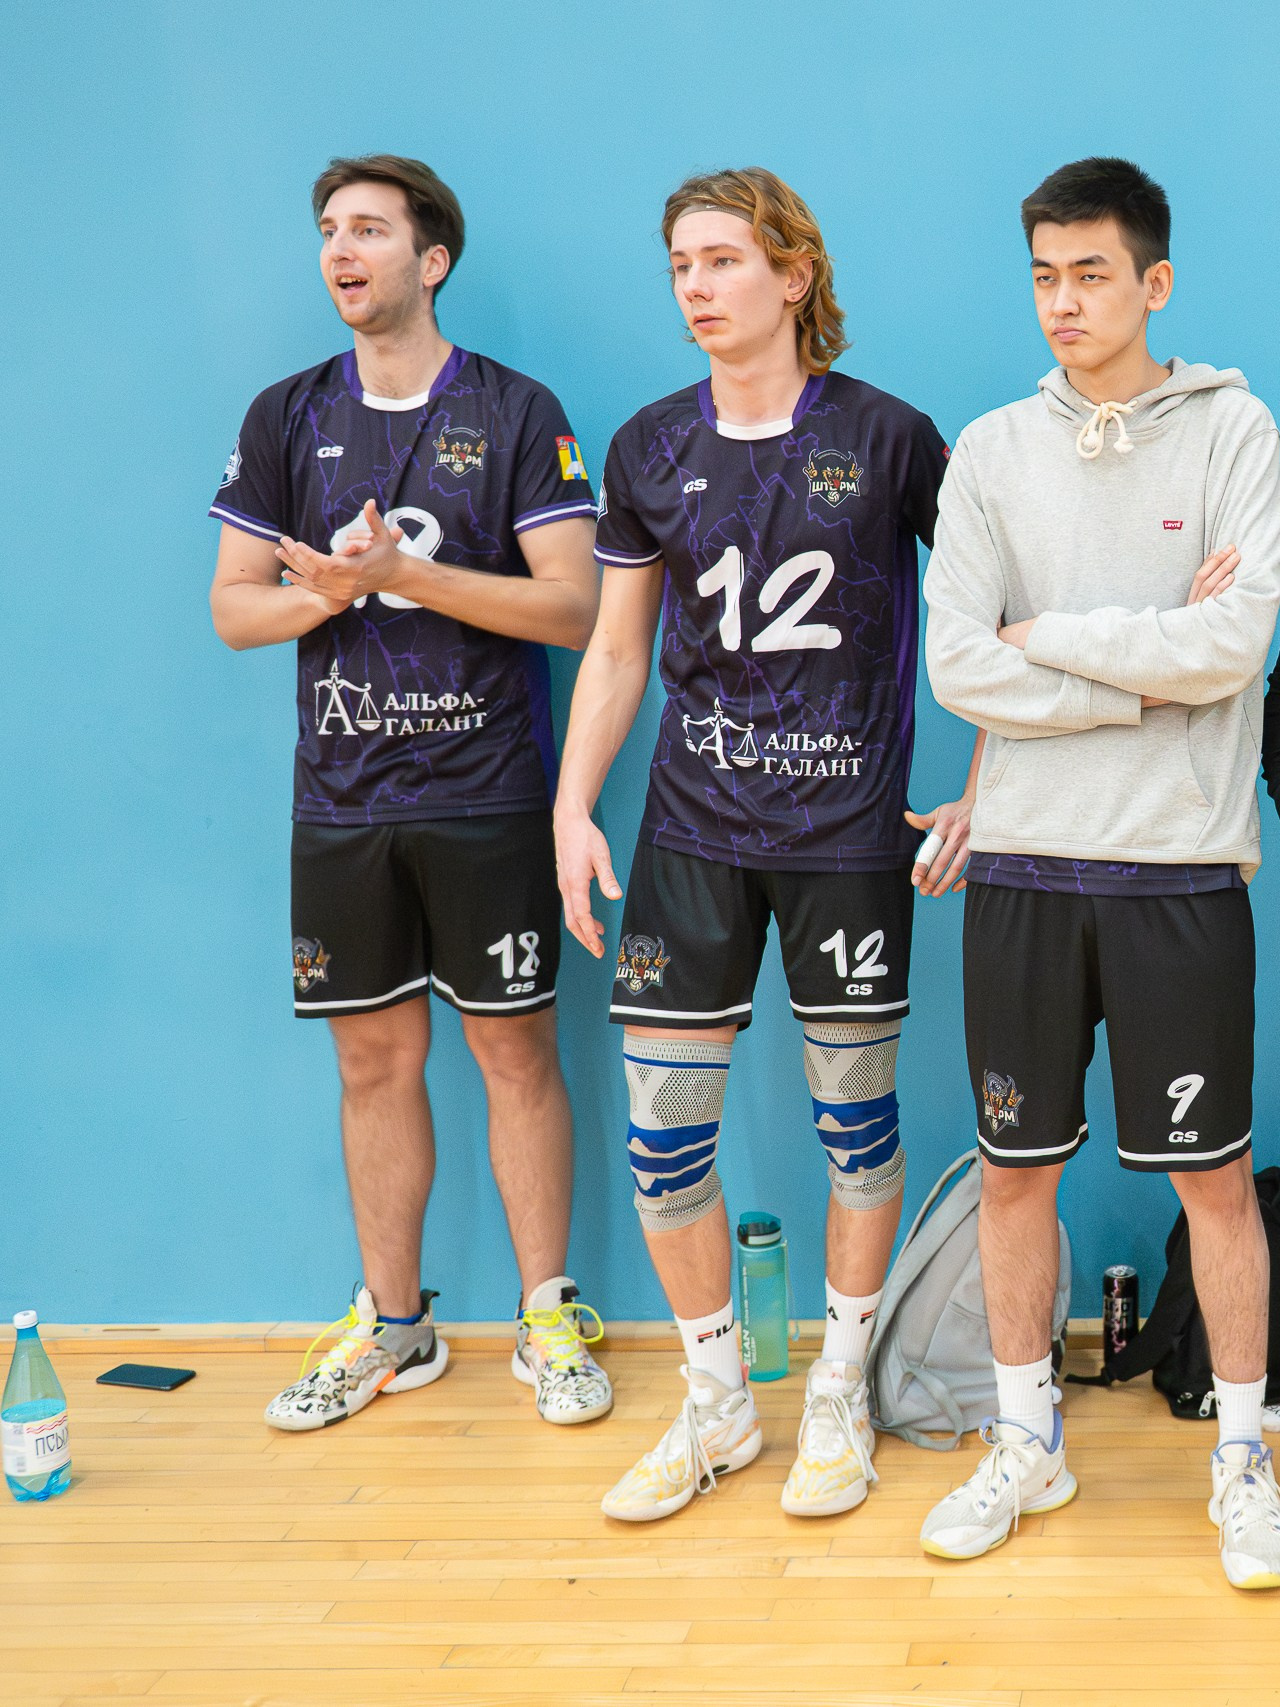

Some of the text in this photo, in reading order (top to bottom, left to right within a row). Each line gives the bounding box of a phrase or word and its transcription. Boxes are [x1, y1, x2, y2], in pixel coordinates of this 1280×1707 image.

[317, 446, 344, 458] GS
[439, 454, 482, 467] ШТРМ
[684, 479, 708, 493] GS
[812, 481, 857, 493] ШТРМ
[696, 545, 843, 652] 12
[383, 691, 485, 711] АЛЬФА-
[385, 712, 487, 736] ГАЛАНТ
[764, 732, 862, 752] АЛЬФА-
[763, 757, 862, 777] ГАЛАНТ
[487, 931, 541, 979] 18
[819, 928, 889, 979] 12
[616, 966, 660, 982] ШТРМ
[506, 981, 536, 994] GS
[845, 983, 873, 996] GS
[1166, 1073, 1205, 1125] 9
[1168, 1130, 1199, 1143] GS
[697, 1314, 735, 1343] FIL
